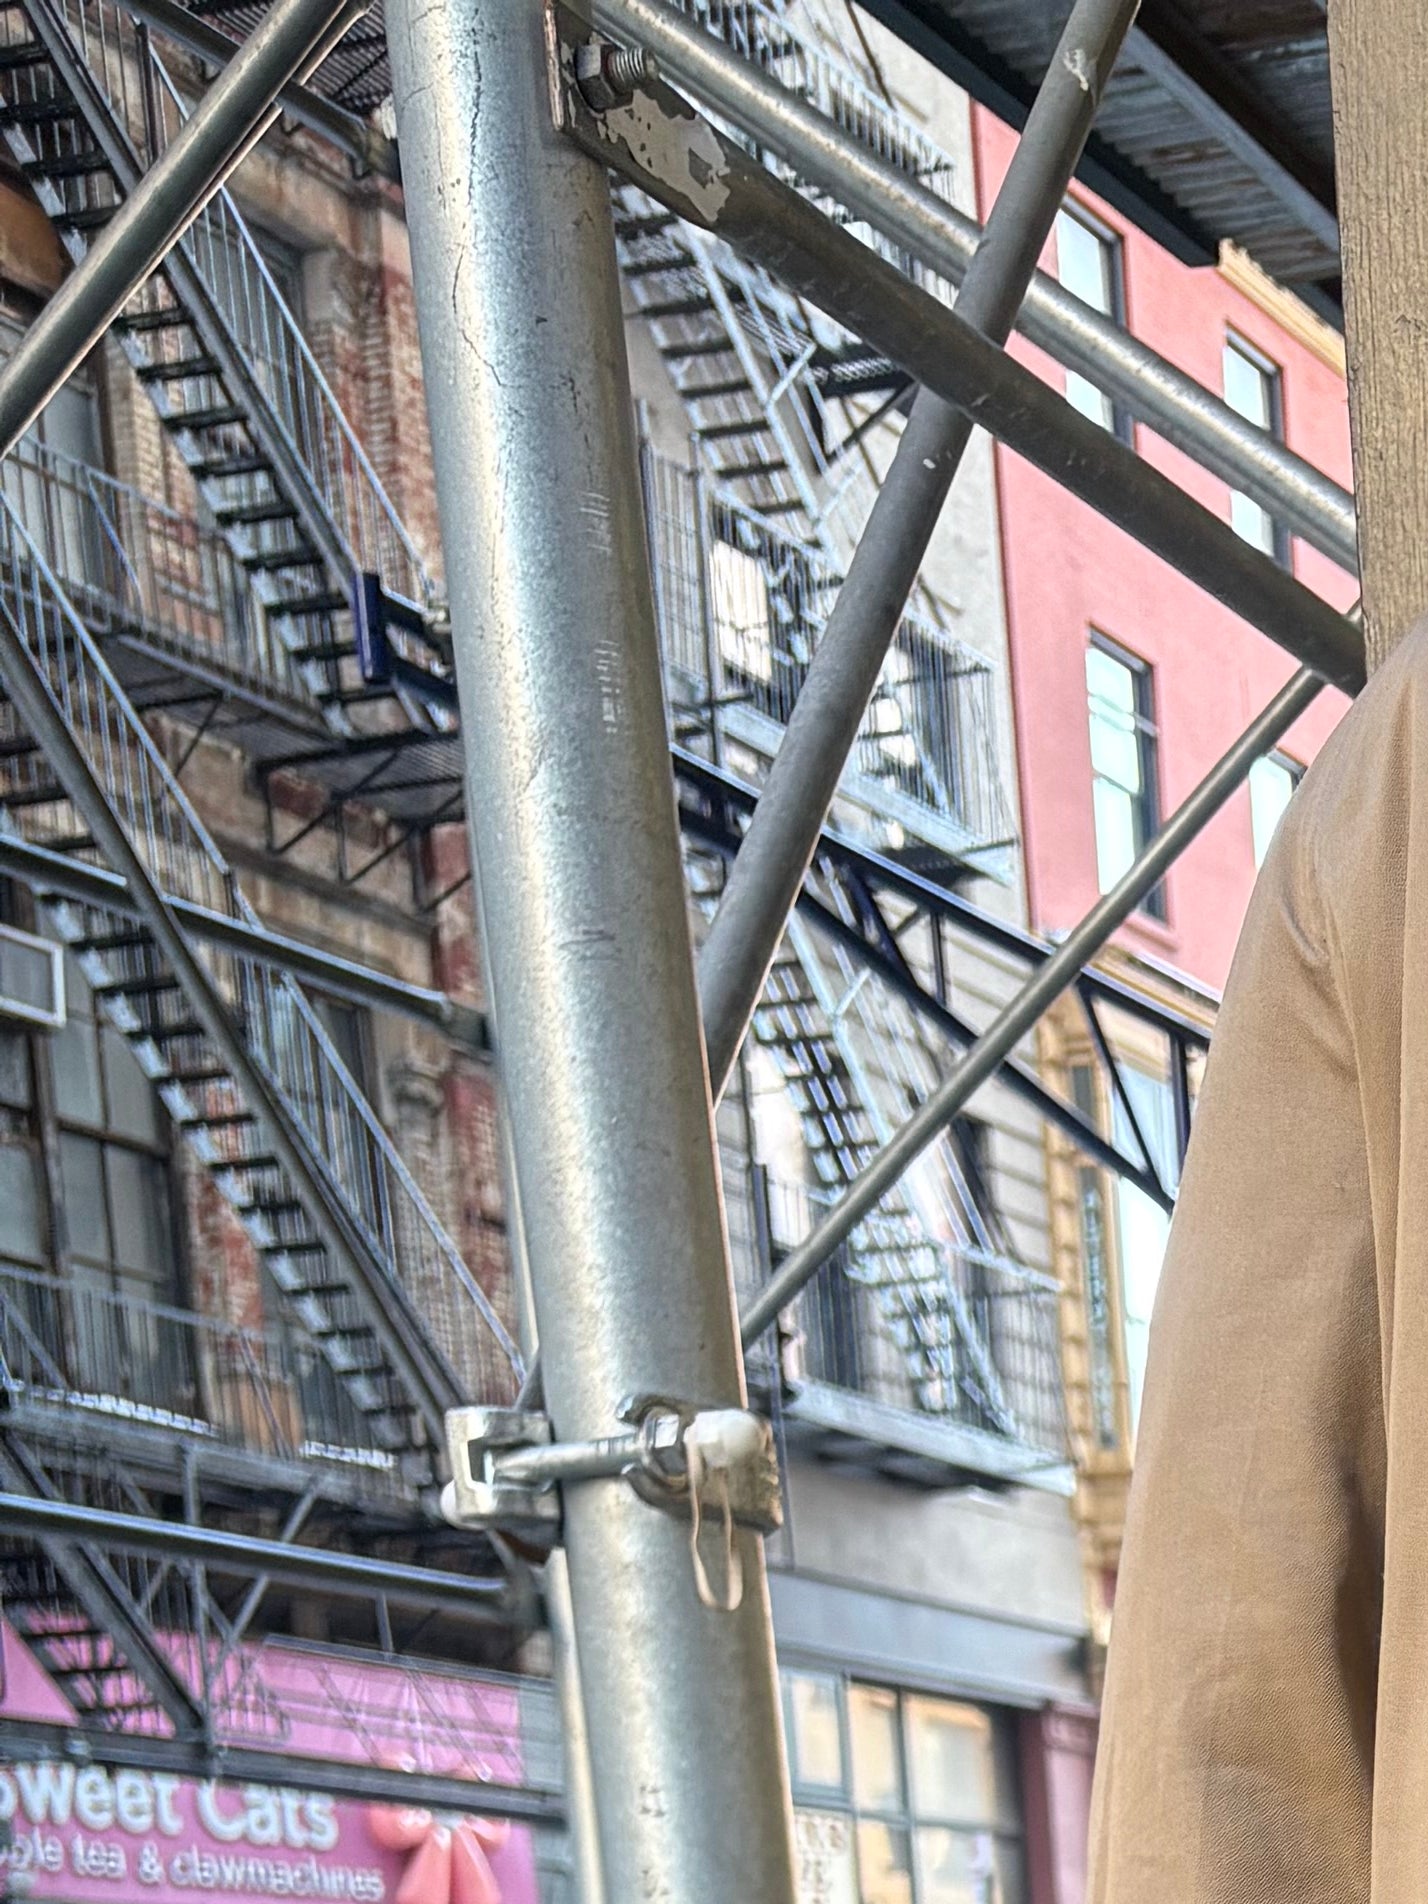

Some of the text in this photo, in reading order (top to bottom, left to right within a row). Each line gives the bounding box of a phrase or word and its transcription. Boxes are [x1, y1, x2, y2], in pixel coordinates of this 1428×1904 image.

[196, 1777, 339, 1852] Cats
[70, 1831, 128, 1879] tea
[138, 1839, 165, 1886] &
